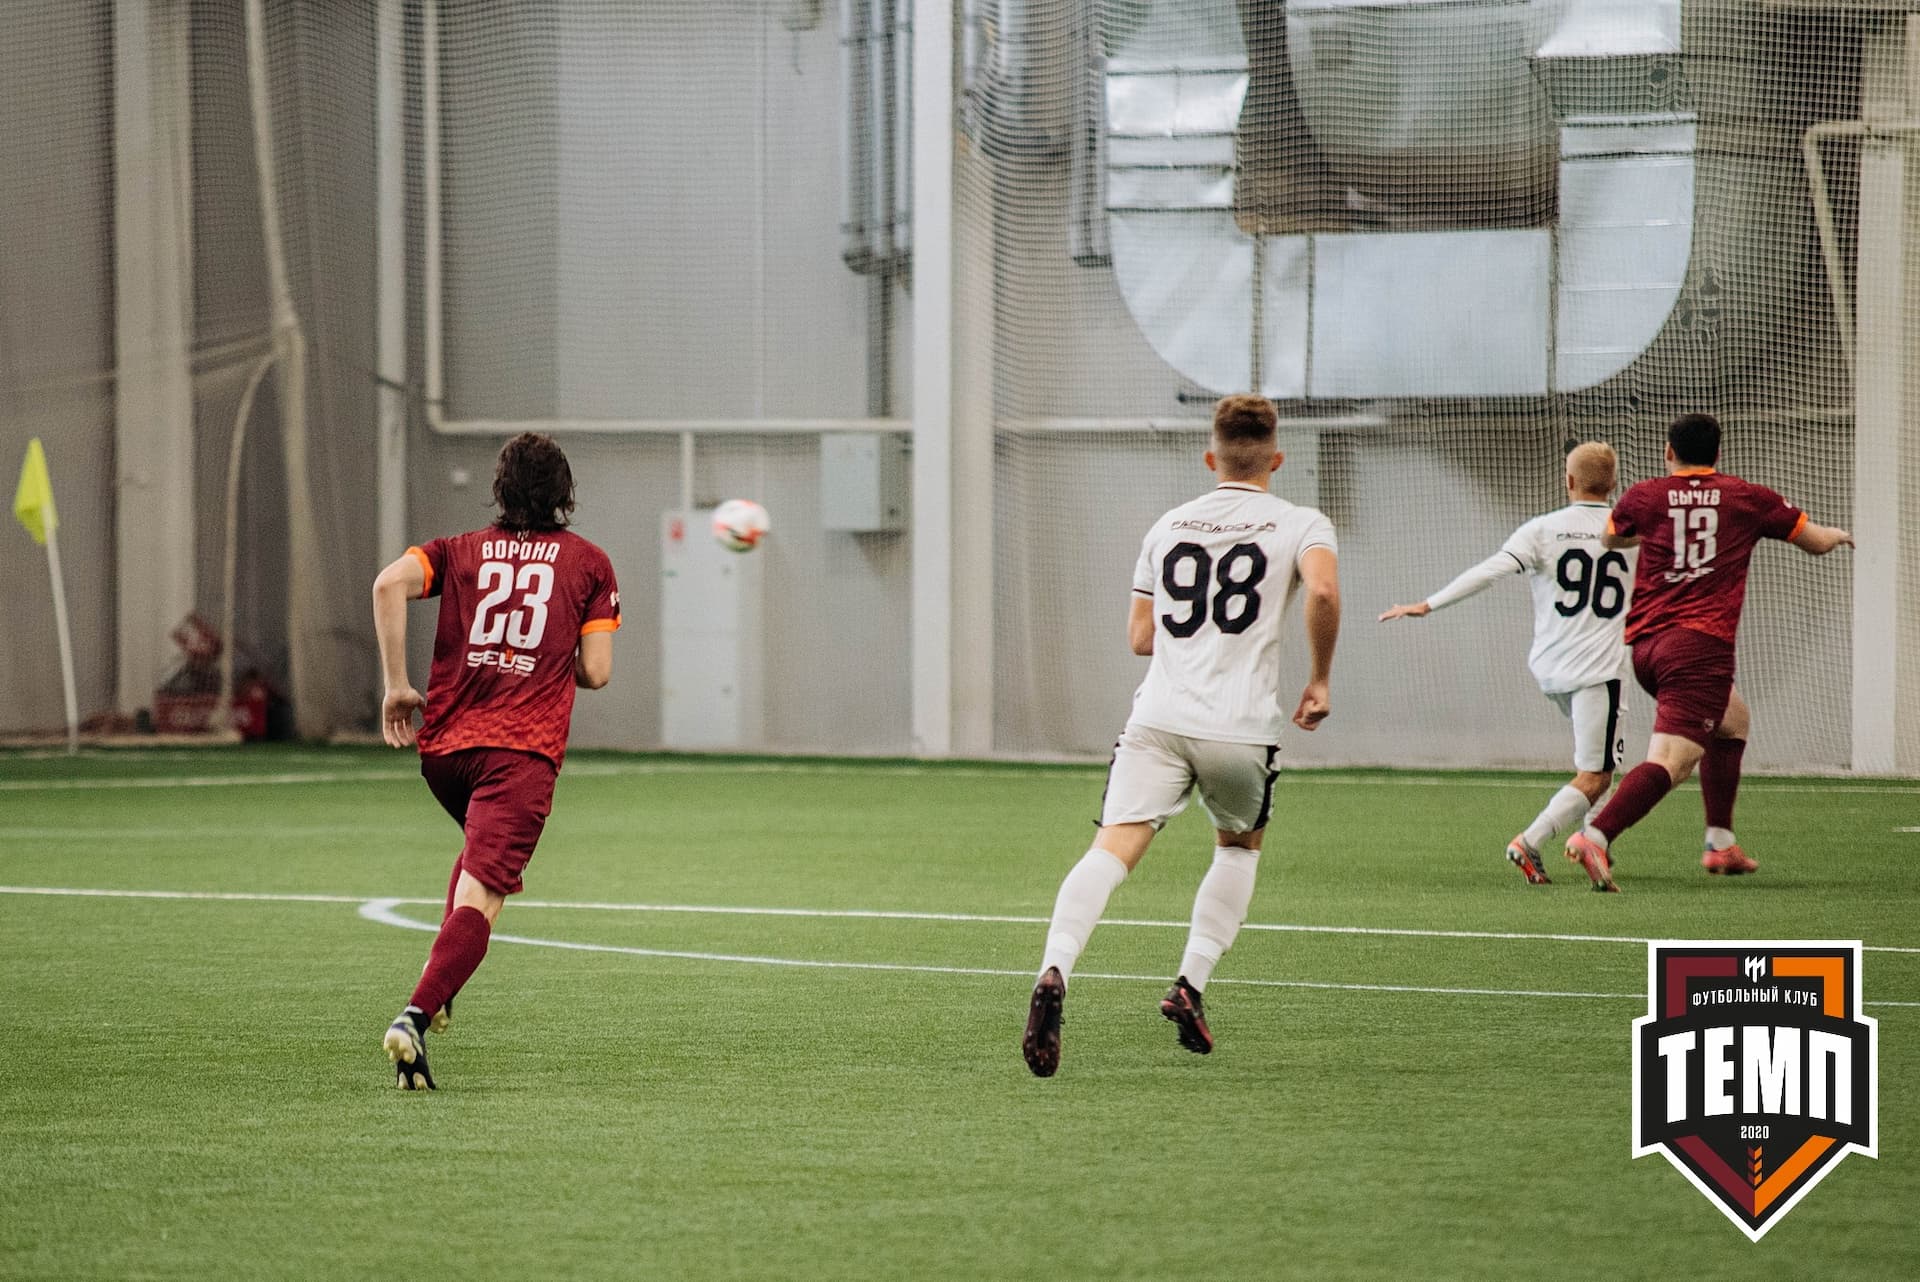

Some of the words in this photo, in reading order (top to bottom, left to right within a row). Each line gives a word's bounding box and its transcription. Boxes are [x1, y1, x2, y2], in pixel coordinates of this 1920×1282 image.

[1668, 489, 1720, 506] СЫЧЕВ
[482, 540, 560, 563] ВОРОНА
[1668, 507, 1719, 569] 13
[468, 561, 555, 649] 23
[1162, 541, 1268, 638] 98
[1554, 548, 1629, 619] 96
[467, 650, 537, 672] SEUS
